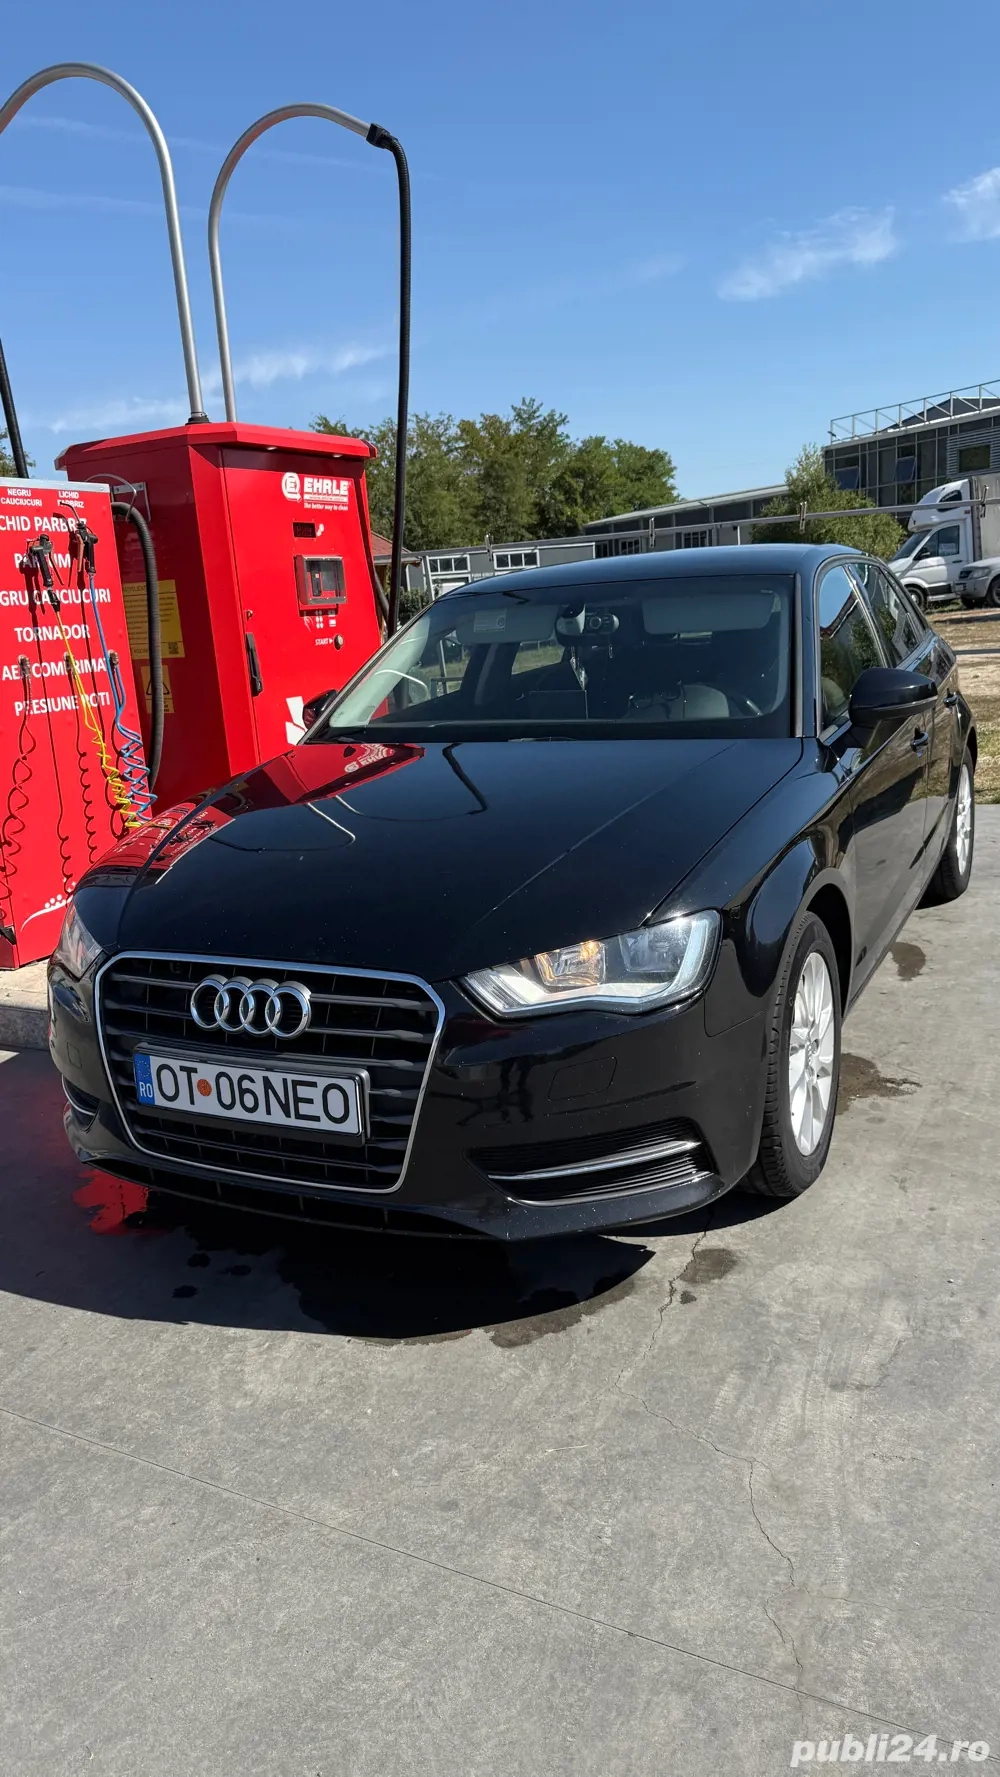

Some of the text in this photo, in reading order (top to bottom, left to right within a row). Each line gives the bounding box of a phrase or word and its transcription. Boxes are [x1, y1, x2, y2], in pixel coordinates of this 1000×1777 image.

[7, 488, 31, 497] NEGRU
[304, 477, 349, 496] EHRLE
[0, 497, 42, 507] CAUCIUCURI
[58, 491, 79, 499] LICHID
[14, 553, 71, 569] PARUM
[14, 624, 90, 643] TORNADOR
[315, 637, 329, 646] START
[2, 657, 108, 681] AE COMRIMA
[139, 1081, 153, 1098] RO
[156, 1063, 198, 1105] OT
